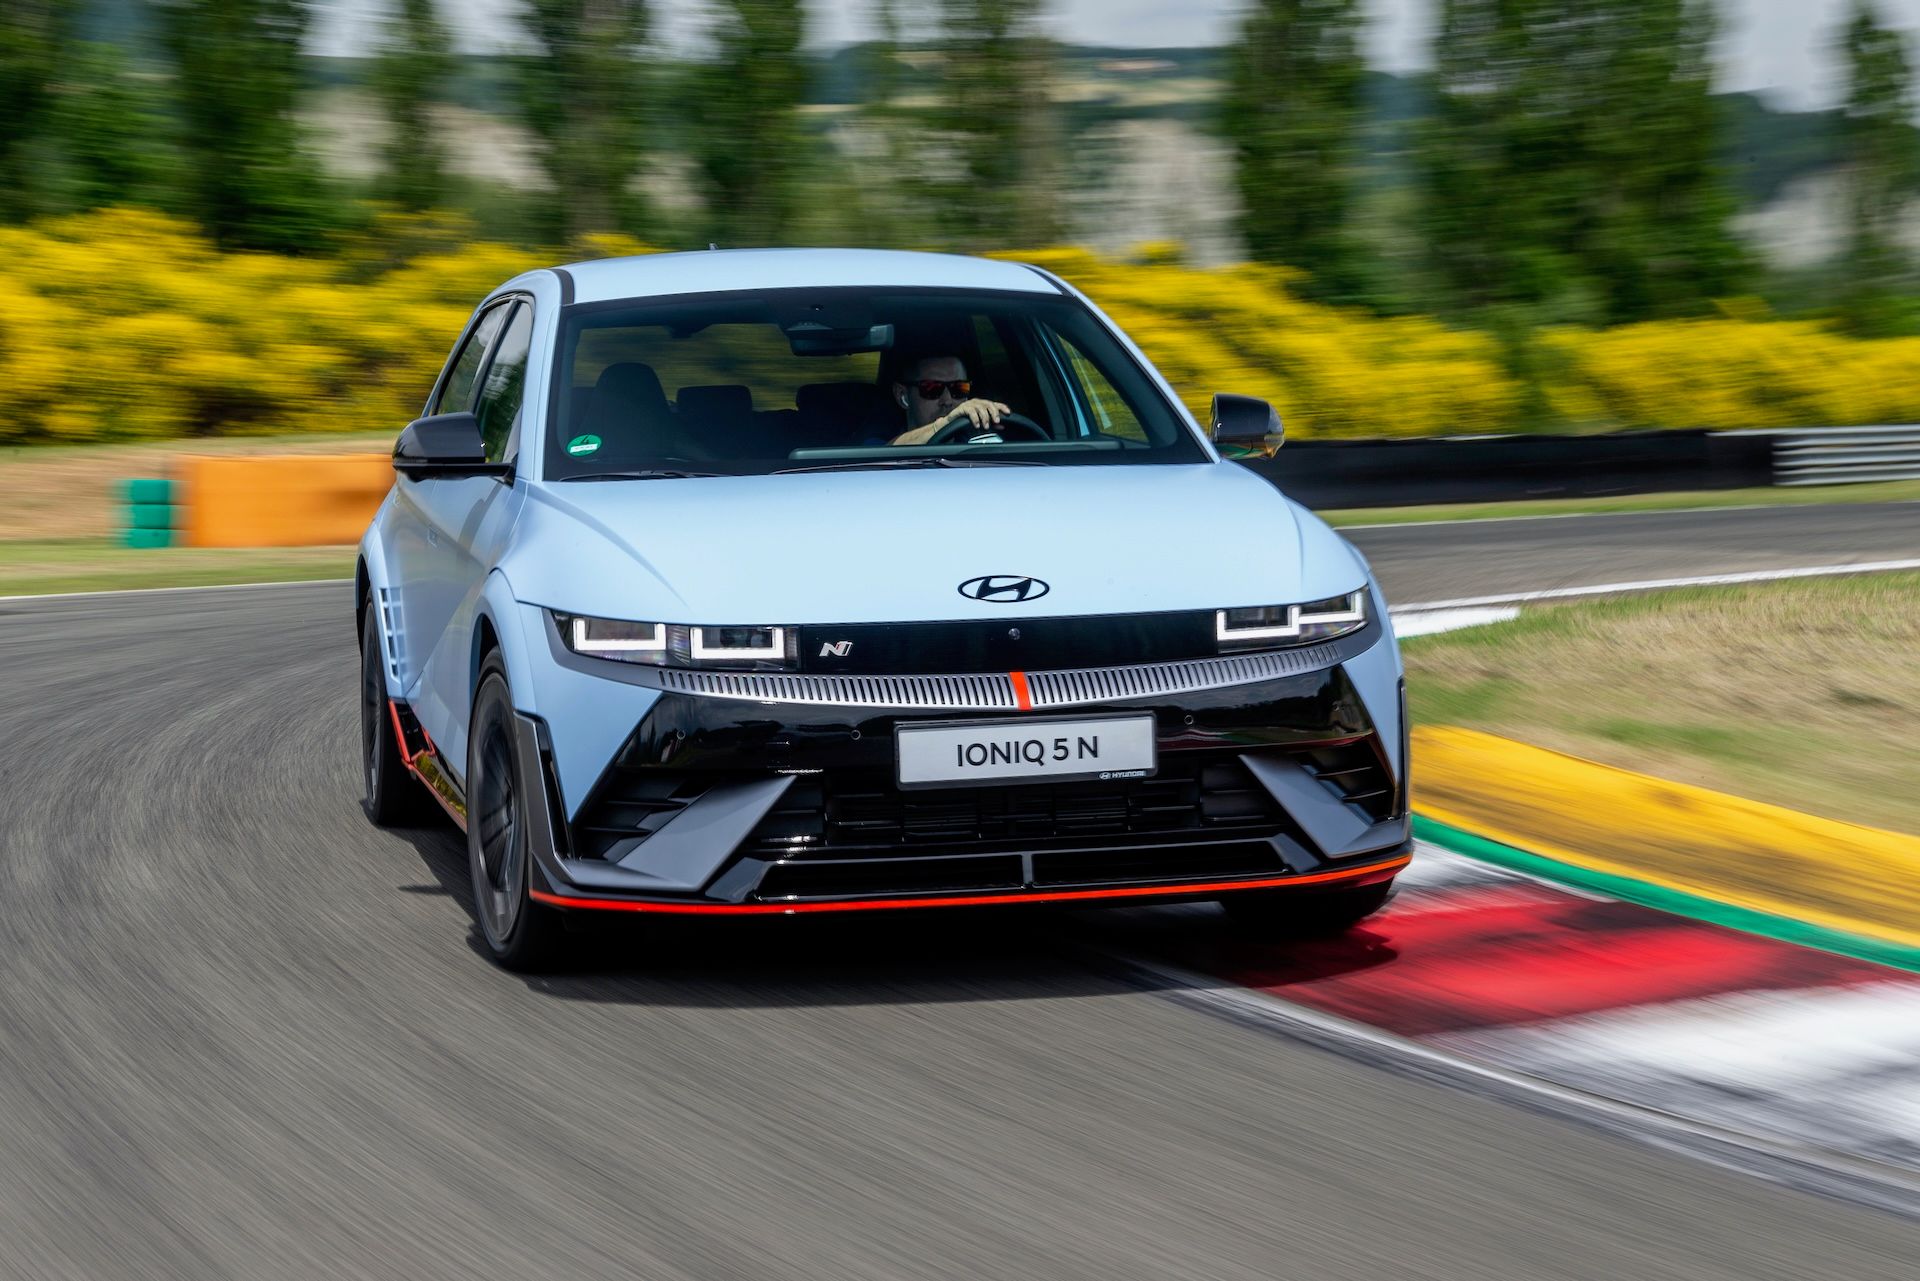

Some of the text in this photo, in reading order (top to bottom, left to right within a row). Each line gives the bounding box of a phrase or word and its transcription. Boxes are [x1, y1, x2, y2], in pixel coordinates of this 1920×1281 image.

[957, 735, 1099, 767] IONIQ 5 N
[1112, 770, 1146, 778] HYUNDAI
